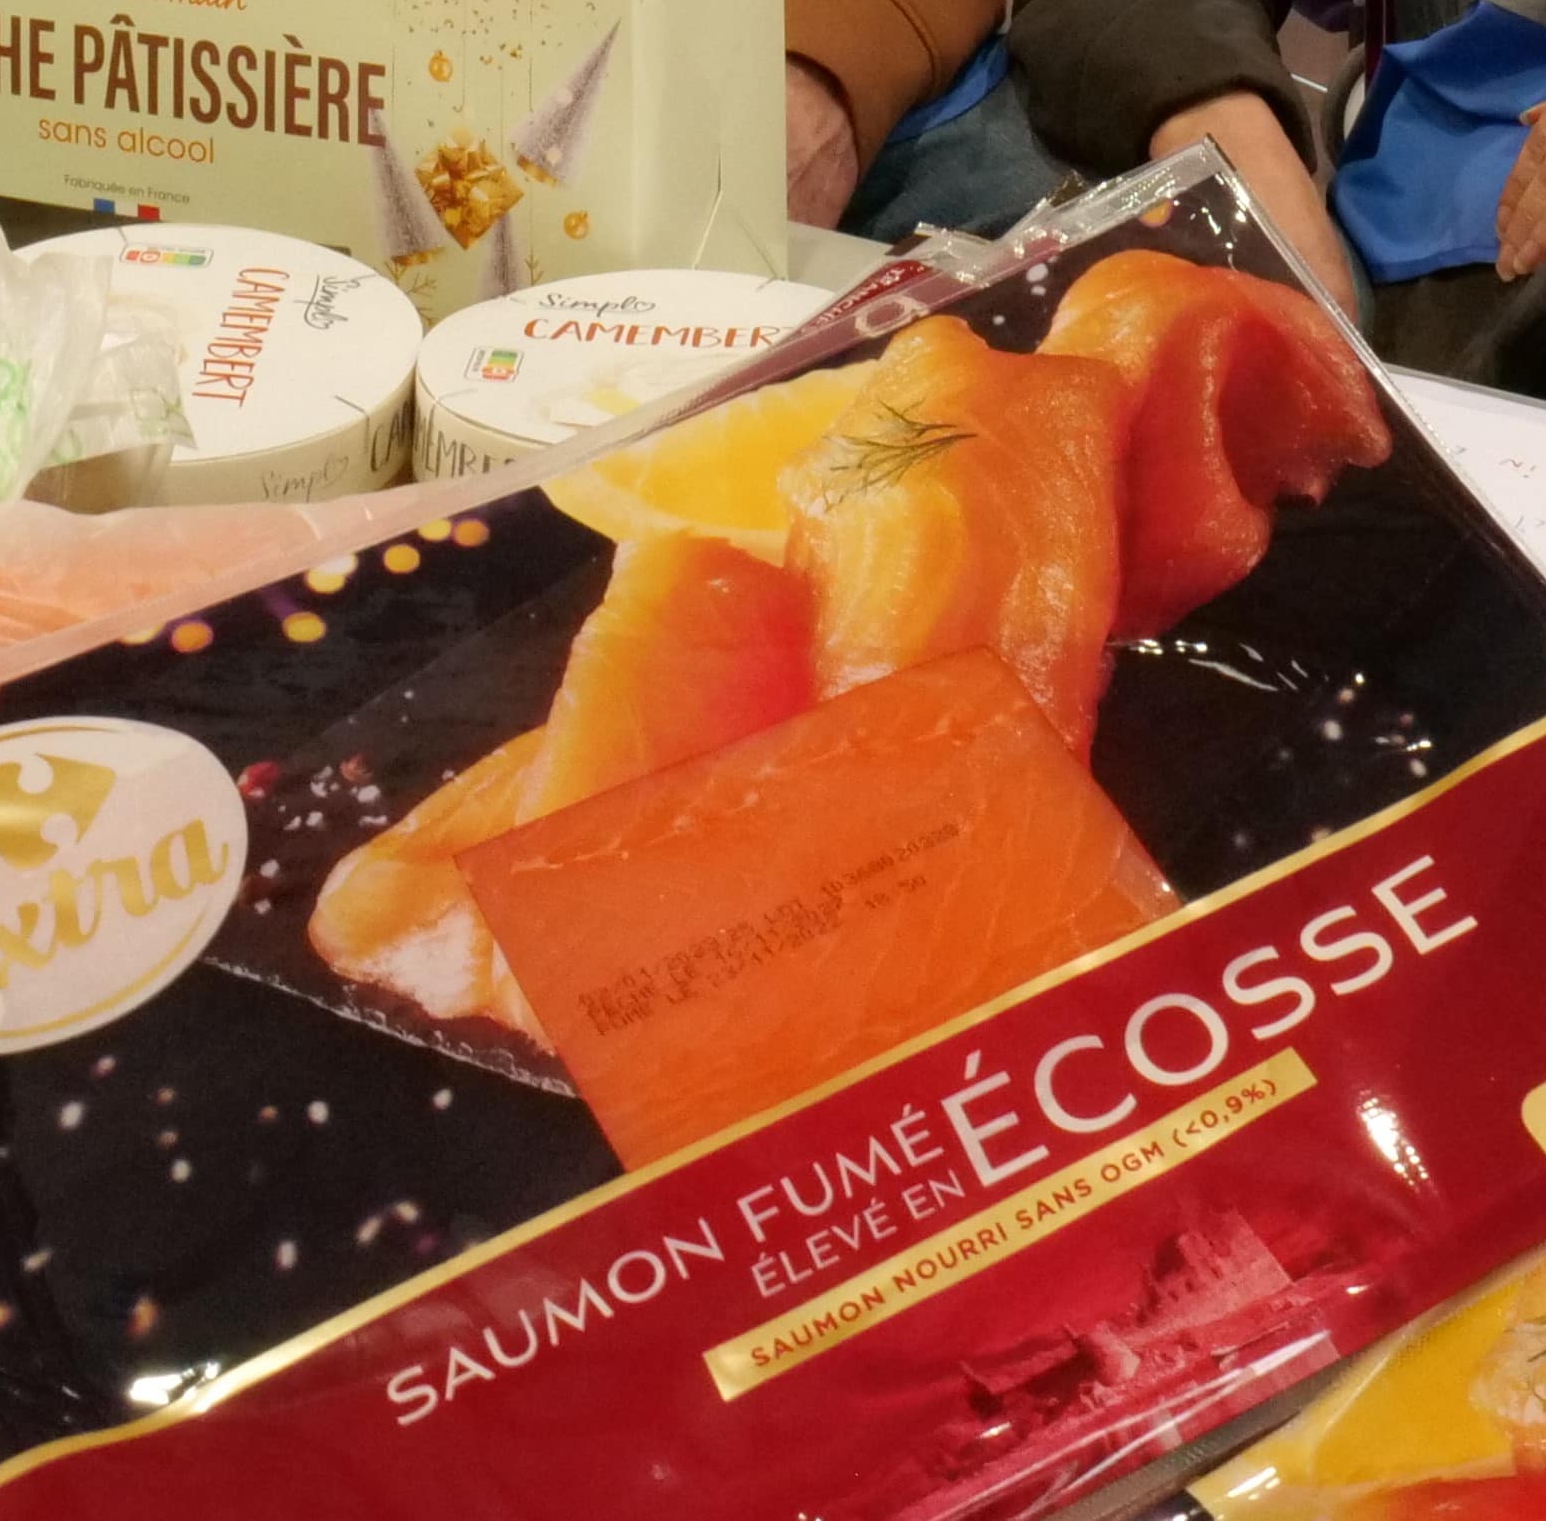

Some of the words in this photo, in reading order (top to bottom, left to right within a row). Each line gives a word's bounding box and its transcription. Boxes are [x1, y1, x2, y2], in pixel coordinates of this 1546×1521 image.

[38, 116, 107, 150] sans
[118, 126, 216, 165] alcool
[73, 12, 387, 148] PÂTISSIÈRE
[62, 173, 126, 199] Fabriquée
[128, 184, 146, 198] en
[147, 186, 191, 205] France
[191, 266, 291, 409] CAMEMBERT
[940, 855, 1477, 1187] ÉCOSSE
[386, 1219, 726, 1427] SAUMON
[739, 1106, 944, 1246] FUMÉ
[749, 1288, 885, 1370] SAUMON
[892, 1219, 1009, 1295] NOURRI
[1013, 1177, 1095, 1234] SANS
[1098, 1140, 1166, 1187] OGM
[1171, 1077, 1278, 1150] (<0,9%)
[751, 1202, 897, 1299] ÉLEVÉ
[903, 1169, 965, 1226] EN
